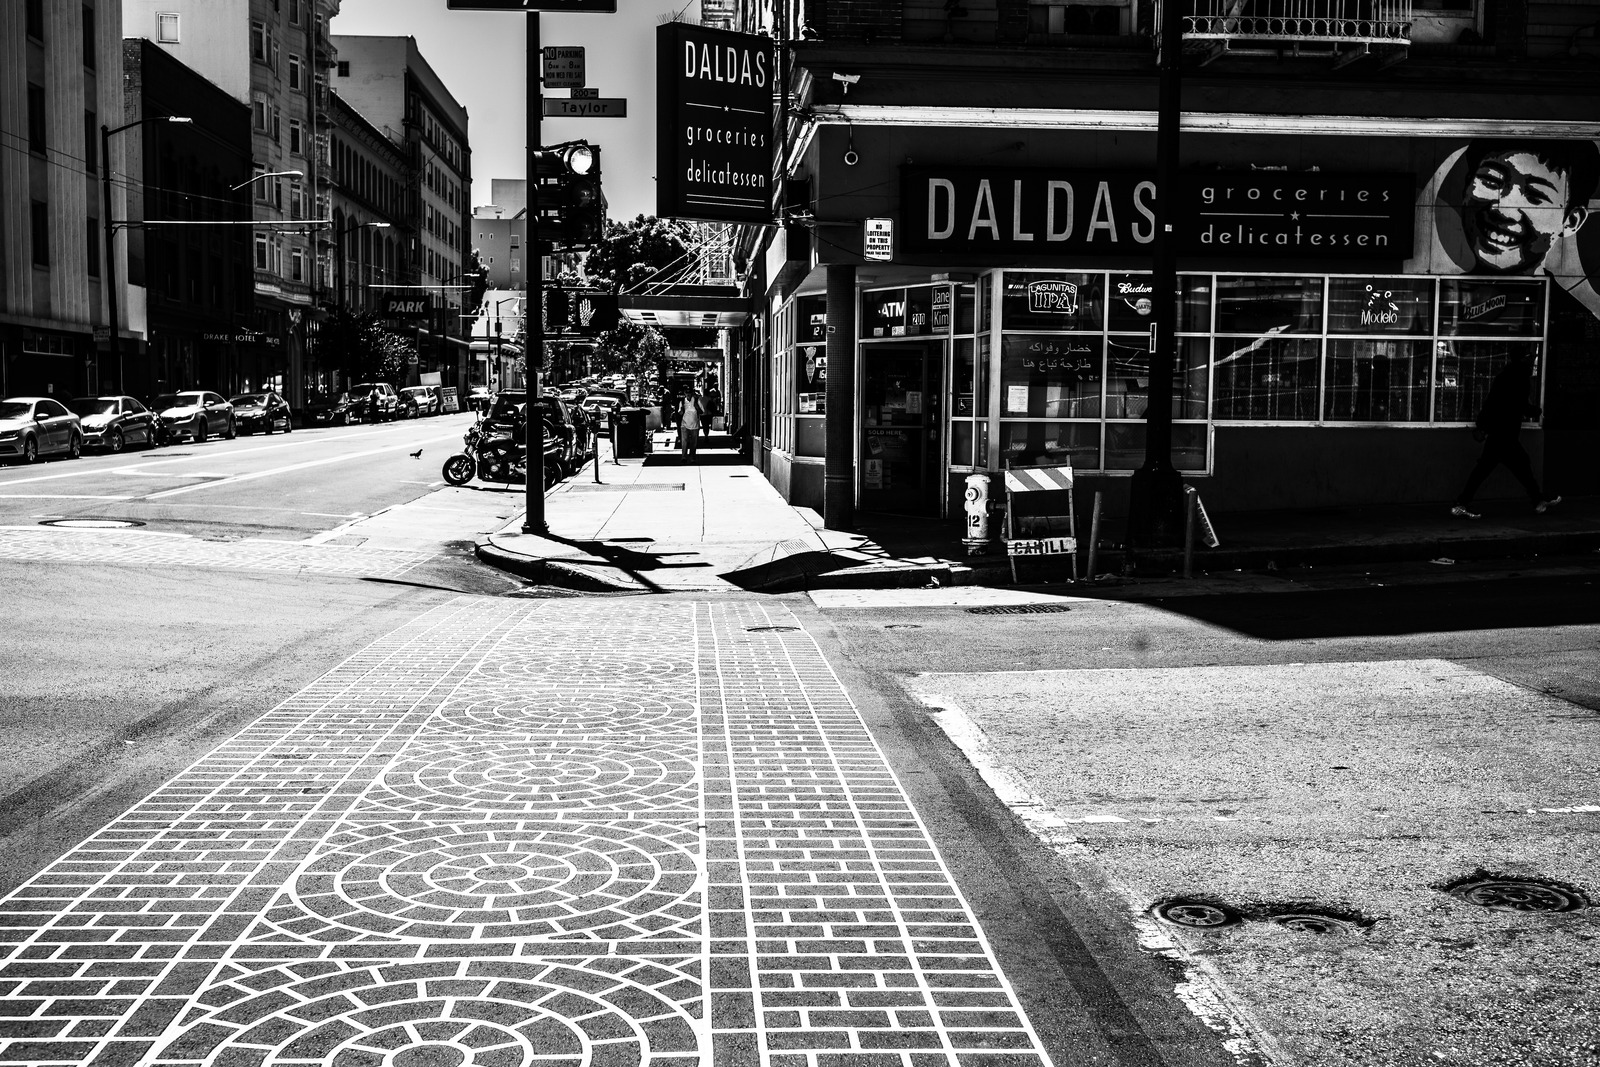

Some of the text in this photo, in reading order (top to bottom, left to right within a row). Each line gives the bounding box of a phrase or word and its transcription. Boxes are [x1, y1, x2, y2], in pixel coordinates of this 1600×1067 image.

[545, 48, 583, 59] NO PARKING
[685, 41, 766, 88] DALDAS
[561, 102, 608, 116] Taylor
[686, 124, 766, 148] groceries
[686, 159, 766, 188] delicatessen
[1201, 185, 1390, 205] groceries
[927, 177, 1156, 244] DALDAS
[1200, 224, 1389, 249] delicatessen
[933, 289, 950, 304] Jane
[1031, 284, 1077, 294] LAGUNITAS
[388, 300, 425, 313] PARK
[881, 301, 905, 317] ATM
[1034, 293, 1072, 309] IPA
[1484, 296, 1505, 312] MOON
[913, 313, 925, 325] 200
[934, 311, 949, 326] Kim
[1361, 309, 1398, 326] Modelo
[203, 333, 229, 341] DRAKE
[968, 514, 981, 528] 12
[1013, 539, 1068, 555] CAHILL
